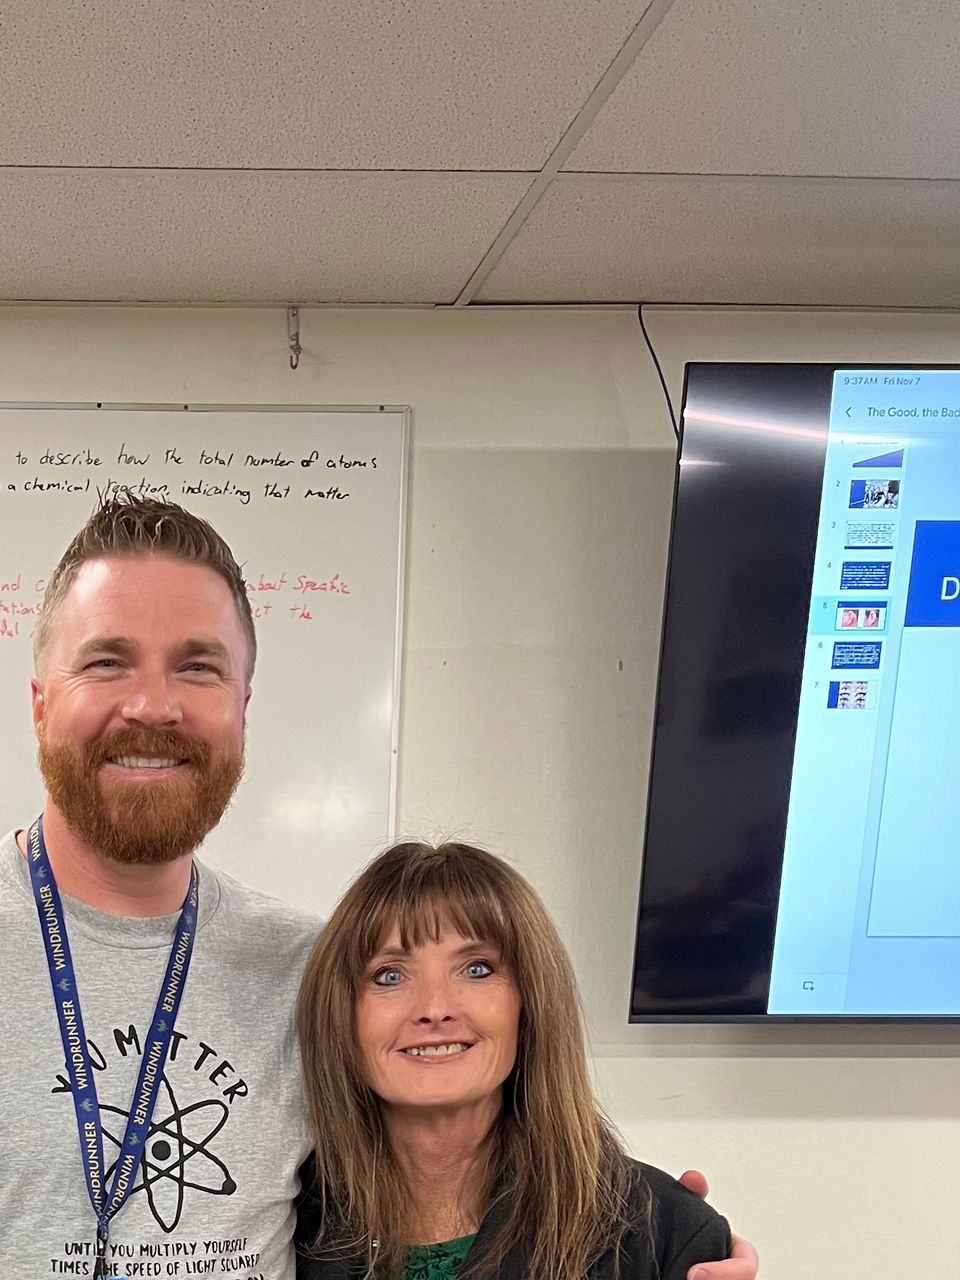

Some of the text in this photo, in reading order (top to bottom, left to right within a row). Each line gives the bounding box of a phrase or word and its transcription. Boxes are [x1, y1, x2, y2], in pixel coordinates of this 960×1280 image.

[884, 377, 895, 385] Fri
[897, 377, 913, 385] Nov
[915, 377, 921, 385] 7
[867, 406, 960, 419] The Good, the Bad
[16, 451, 28, 466] to
[39, 448, 103, 467] describe
[117, 443, 150, 466] how
[199, 450, 234, 467] total
[243, 451, 295, 467] number
[300, 450, 319, 468] of
[326, 454, 377, 469] atoms
[7, 482, 16, 492] a
[24, 477, 90, 493] chemical
[182, 480, 251, 505] indicating
[264, 483, 290, 498] that
[304, 486, 350, 500] matter
[290, 604, 313, 620] the
[40, 884, 66, 971] WINDRUNNER
[161, 931, 191, 1013] WINDRUNNER
[62, 999, 88, 1090] WINDRUNNER
[113, 1024, 249, 1105] MTTER
[133, 1040, 163, 1126] WINDRUNNER
[110, 1244, 135, 1258] YOU
[140, 1242, 198, 1257] MULTIPLY
[203, 1237, 248, 1254] YOURSELF
[51, 1259, 90, 1275] TIMES
[126, 1262, 161, 1277] SPEED
[167, 1261, 181, 1276] OF
[186, 1259, 217, 1274] LIGHT
